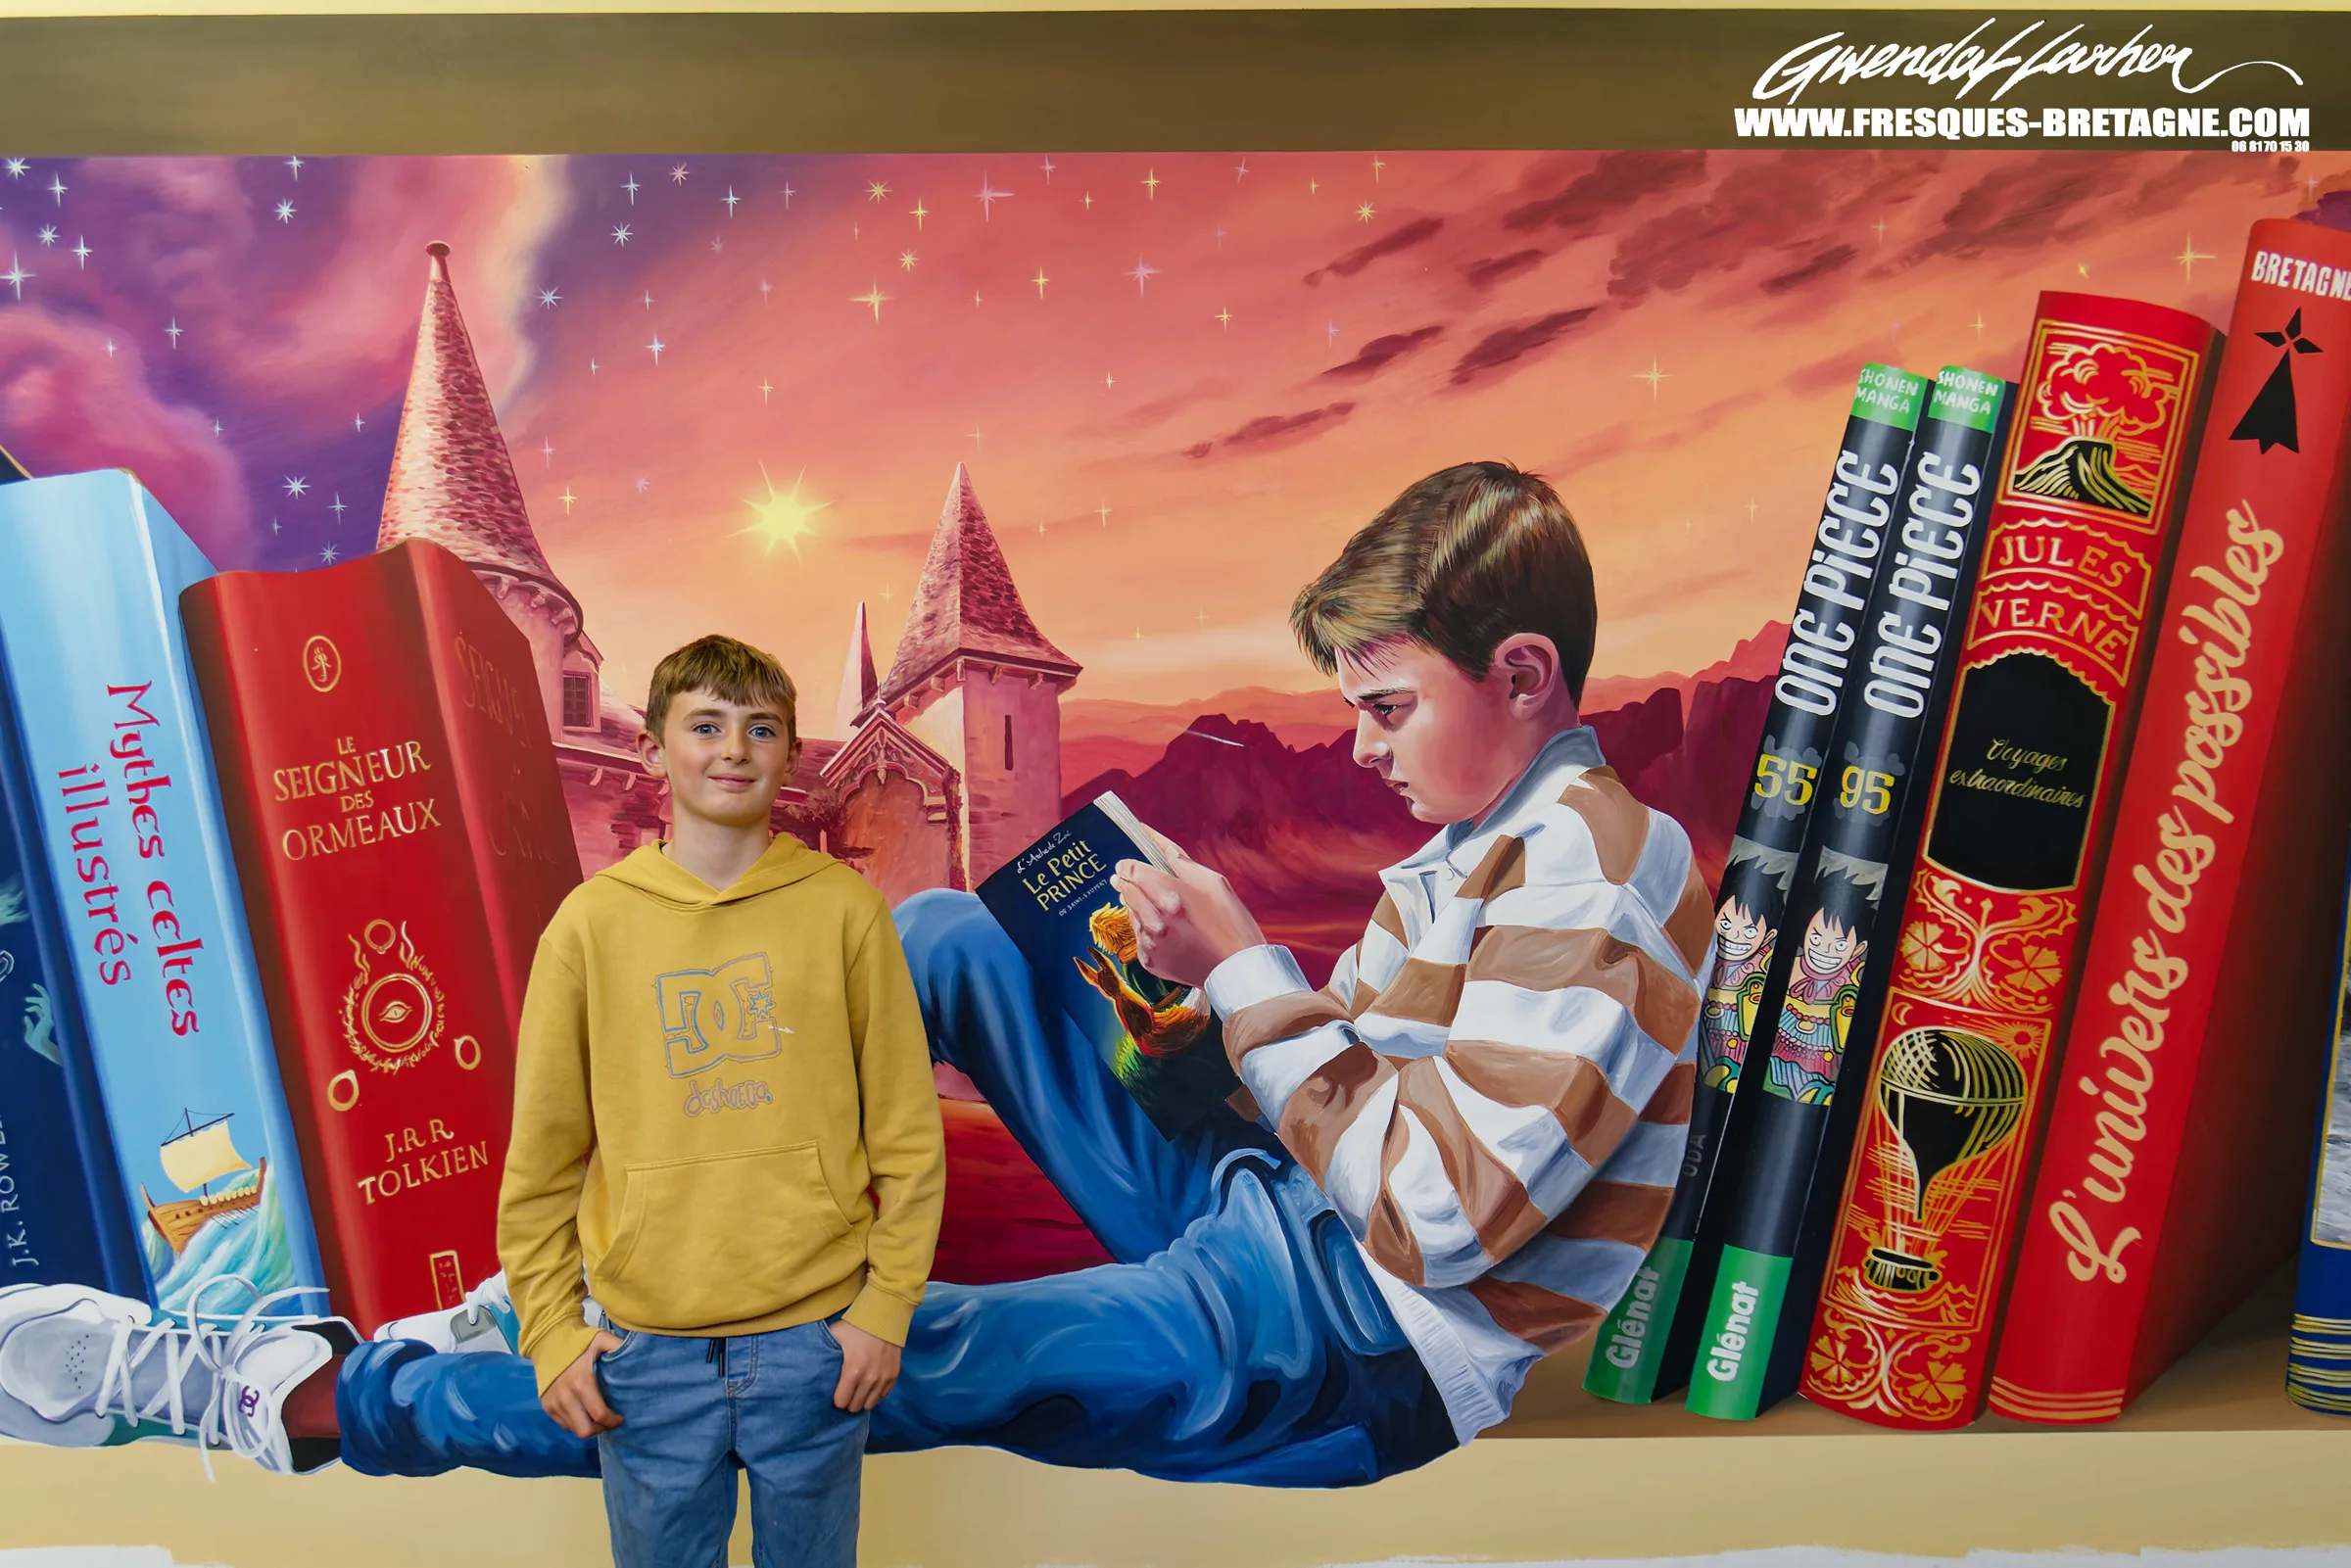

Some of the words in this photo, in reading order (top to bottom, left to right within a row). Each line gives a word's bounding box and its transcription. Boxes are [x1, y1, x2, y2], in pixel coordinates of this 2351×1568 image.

[1854, 386, 1910, 413] MANGA
[1859, 368, 1919, 397] SHONEN
[1933, 390, 1991, 415] MANGA
[1937, 370, 1999, 397] SHONEN
[1998, 535, 2132, 588] JULES
[1981, 597, 2130, 661] VERNE
[2171, 499, 2284, 824] possibles
[273, 740, 432, 802] SEIGNEUR
[337, 736, 357, 755] LE
[1987, 736, 2068, 774] Voyages
[339, 790, 374, 813] DES
[1753, 753, 1818, 807] 55
[1839, 765, 1895, 815] 95
[1949, 768, 2086, 808] extraordinaires
[282, 798, 442, 861] ORMEAUX
[58, 763, 139, 986] illustrés
[107, 680, 172, 859] Mythes
[147, 880, 204, 1036] celtes
[1022, 873, 1049, 894] Le
[1047, 840, 1092, 877] Petit
[1036, 853, 1107, 912] PRINCE
[2133, 805, 2216, 934] des
[2048, 928, 2189, 1284] L'univers
[358, 1140, 489, 1206] TOLKIEN
[7, 1220, 39, 1265] J.K.
[1606, 1266, 1659, 1369] Glénat
[1706, 1281, 1759, 1382] Glénat
